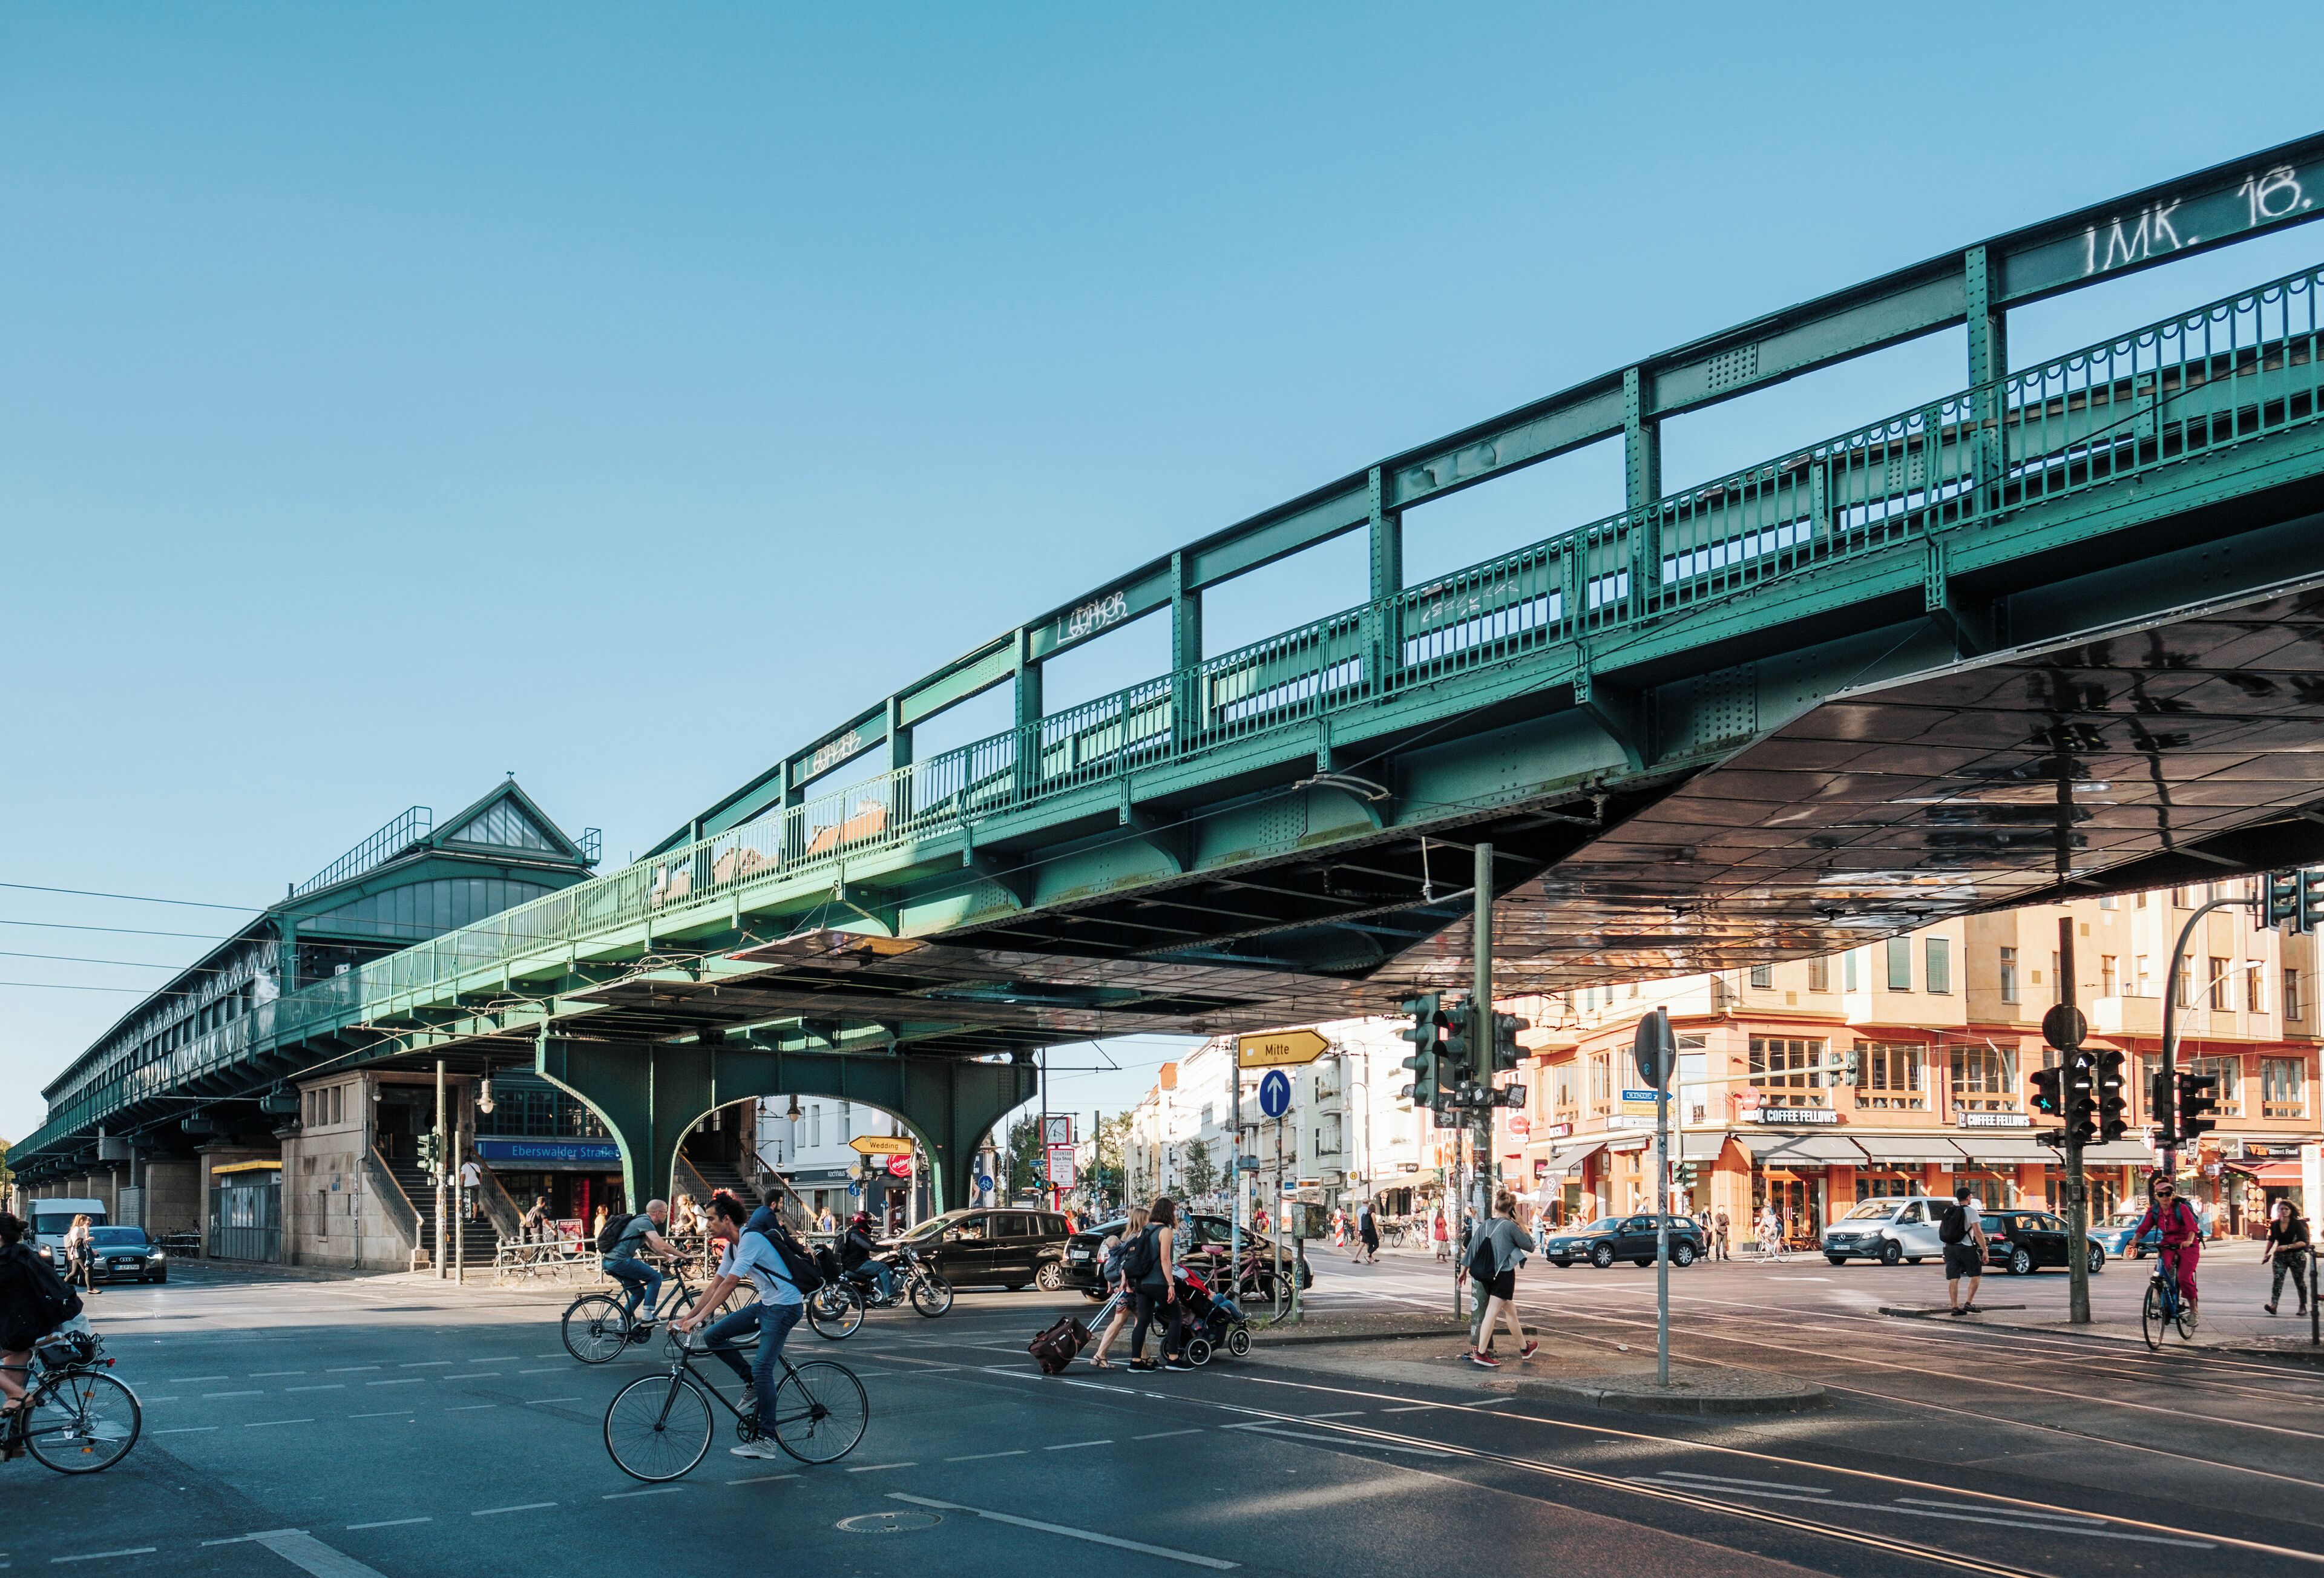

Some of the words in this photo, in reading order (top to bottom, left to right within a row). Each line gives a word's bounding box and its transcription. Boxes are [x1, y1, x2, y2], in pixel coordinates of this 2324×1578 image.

[1265, 1044, 1290, 1056] Mitte
[2075, 1057, 2087, 1068] A
[1767, 1110, 1799, 1122] COFFEE
[1799, 1110, 1837, 1123] FELLOWS
[1967, 1114, 1996, 1126] COFFEE
[1996, 1115, 2030, 1126] FELLOWS
[512, 1145, 577, 1157] Eberswalder
[870, 1142, 899, 1150] Wedding
